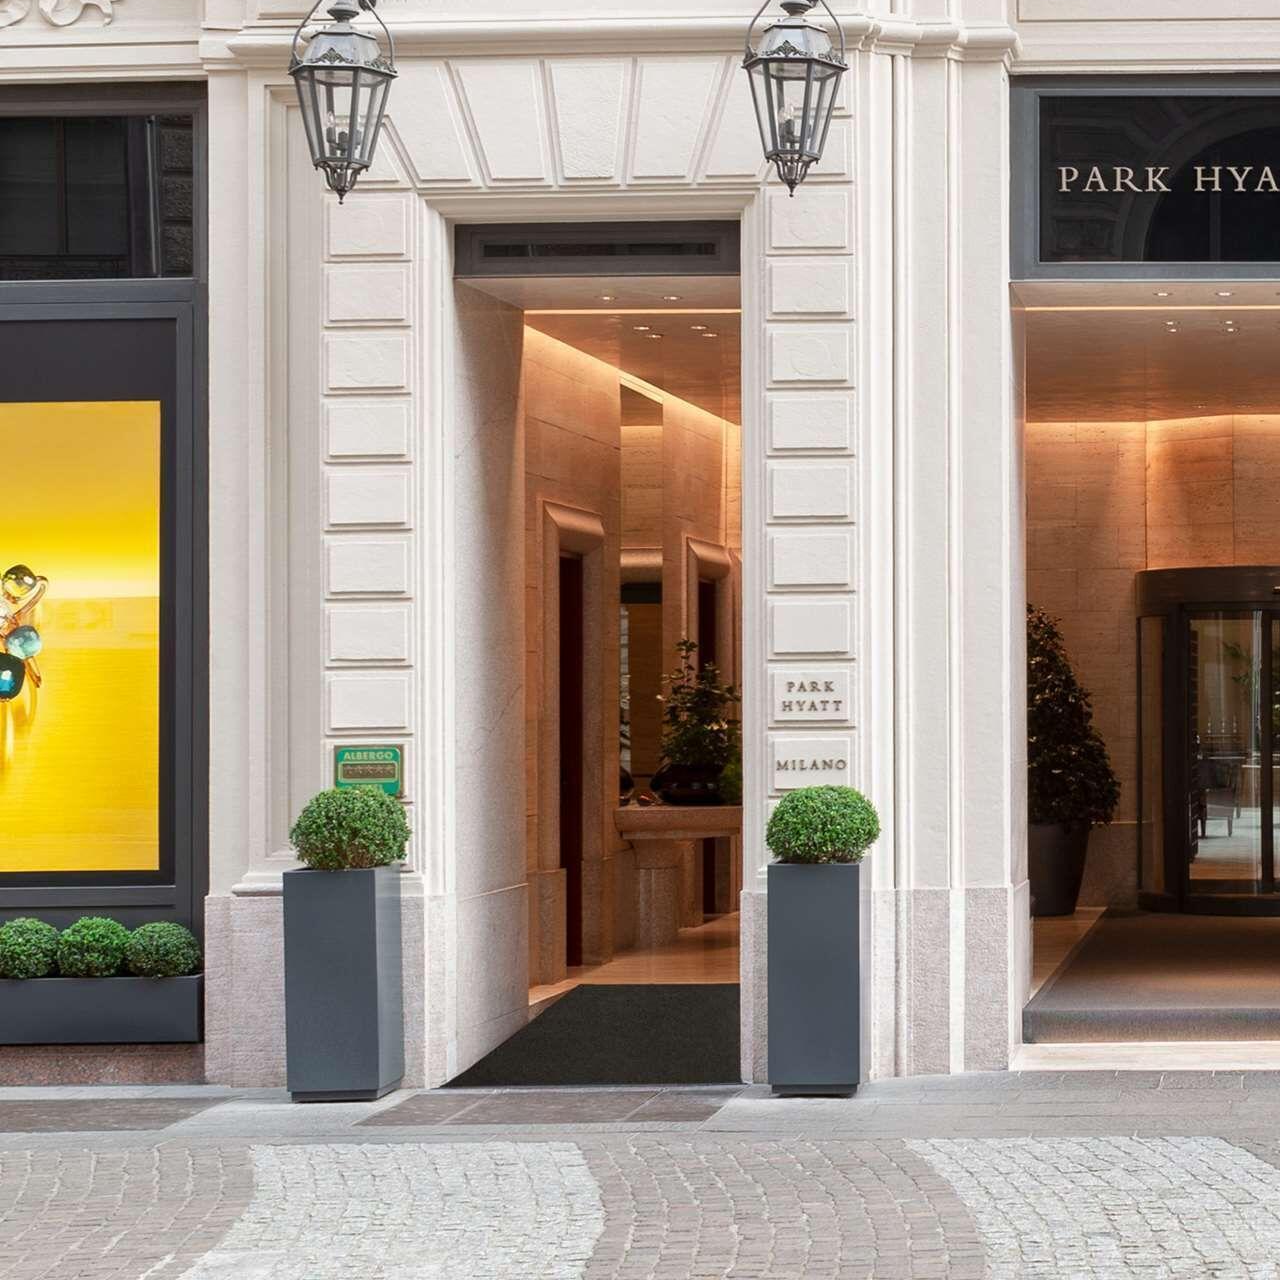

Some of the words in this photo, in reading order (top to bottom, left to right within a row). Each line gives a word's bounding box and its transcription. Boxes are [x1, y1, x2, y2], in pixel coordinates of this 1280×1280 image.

[1057, 165, 1172, 193] PARK
[786, 681, 835, 693] PARK
[781, 700, 843, 712] HYATT
[343, 751, 394, 761] ALBERGO
[775, 759, 848, 771] MILANO
